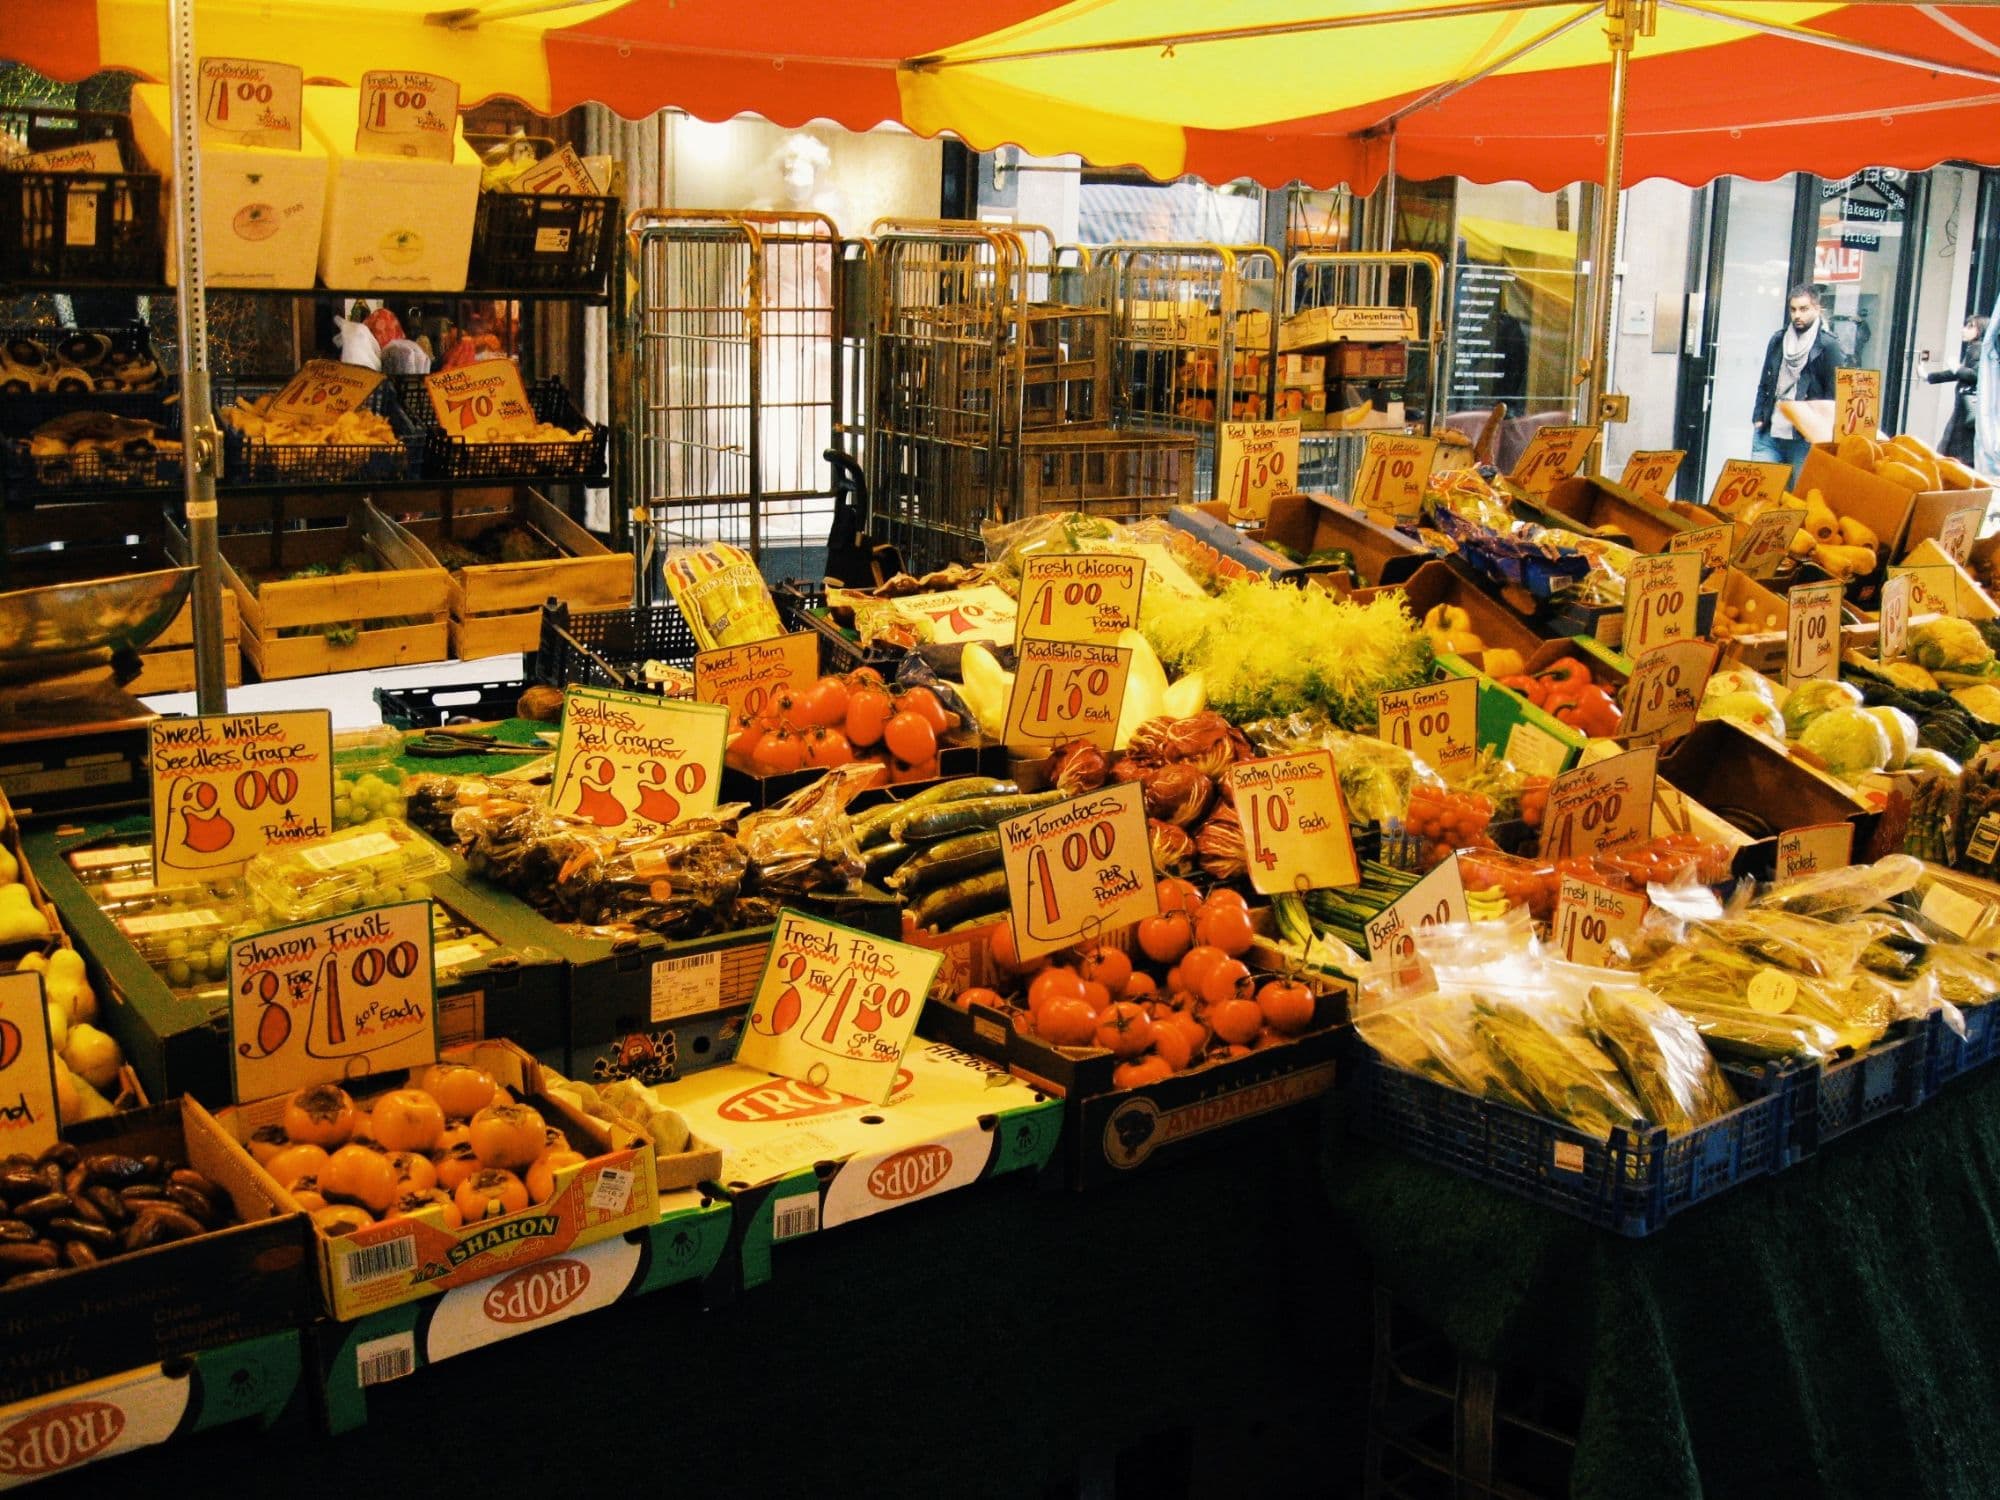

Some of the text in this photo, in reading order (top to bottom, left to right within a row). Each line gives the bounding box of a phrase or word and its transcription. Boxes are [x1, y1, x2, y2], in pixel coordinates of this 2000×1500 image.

[1814, 246, 1860, 275] SALE
[1028, 558, 1135, 589] Fresh Chicory
[698, 645, 785, 674] Sweet Plum
[1084, 647, 1118, 665] Salad
[568, 698, 636, 726] Seedless
[1084, 706, 1112, 721] Each
[1381, 689, 1449, 717] Baby Gems
[153, 717, 284, 745] Sweet White
[572, 721, 683, 757] Red Grape
[155, 742, 314, 772] Seedless Grape
[1234, 760, 1323, 791] Spring Onions
[261, 817, 327, 839] Punnet
[1005, 797, 1123, 845] Vine Tomatoes
[1298, 811, 1327, 829] Each
[1092, 870, 1140, 901] Pound
[1593, 891, 1625, 915] Herbs
[237, 912, 391, 968] Sharon Fruit
[1370, 907, 1402, 951] Basil
[784, 919, 896, 983] Fresh Figs
[238, 969, 292, 1059] 3
[379, 998, 424, 1025] Each
[873, 1037, 902, 1060] Each
[726, 1080, 843, 1121] TRO
[872, 1150, 949, 1196] TROPS
[451, 1217, 557, 1263] SHARON
[487, 1263, 584, 1321] TROPS
